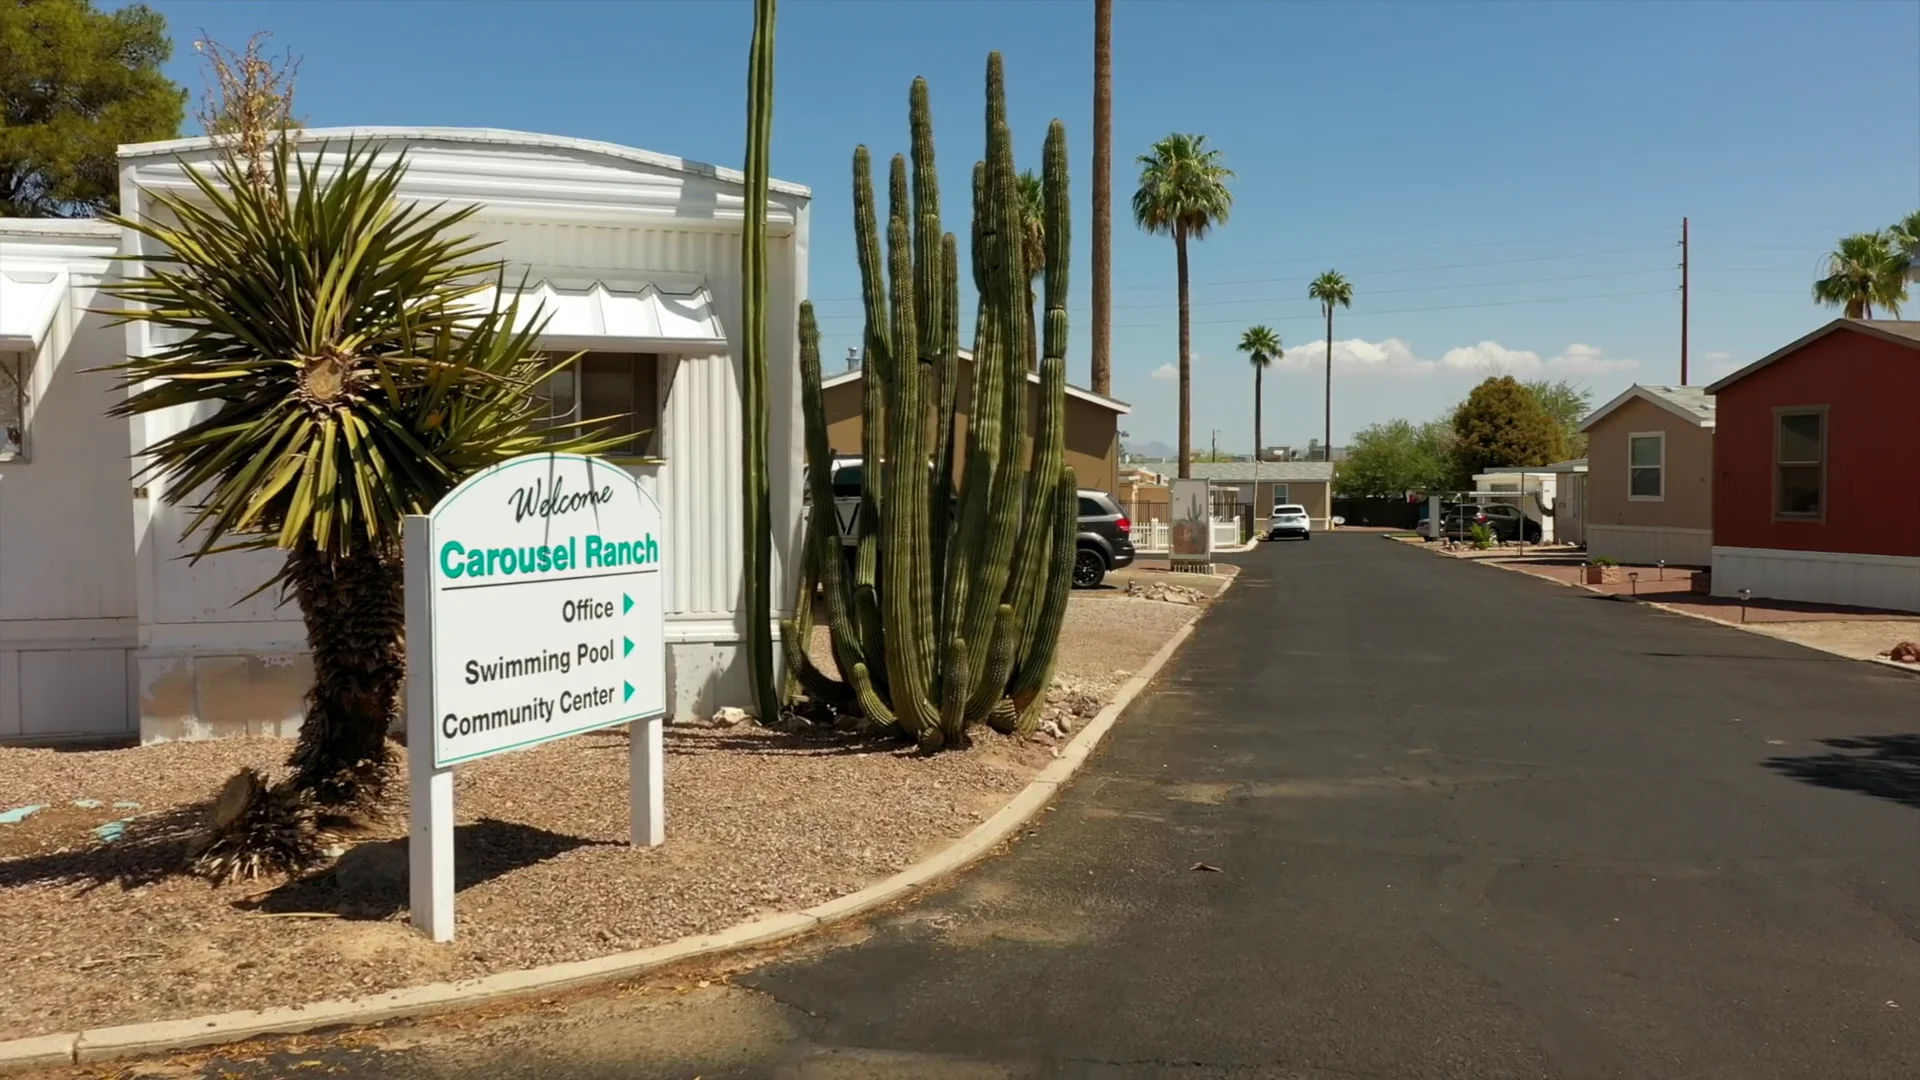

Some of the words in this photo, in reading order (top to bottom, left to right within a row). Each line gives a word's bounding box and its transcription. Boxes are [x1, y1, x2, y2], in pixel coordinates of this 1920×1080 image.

[508, 475, 613, 523] Welcome
[440, 536, 576, 579] Carousel
[586, 533, 658, 568] Ranch
[562, 598, 614, 623] Office
[465, 649, 570, 685] Swimming
[577, 639, 614, 666] Pool
[443, 696, 554, 739] Community
[560, 685, 615, 714] Center
